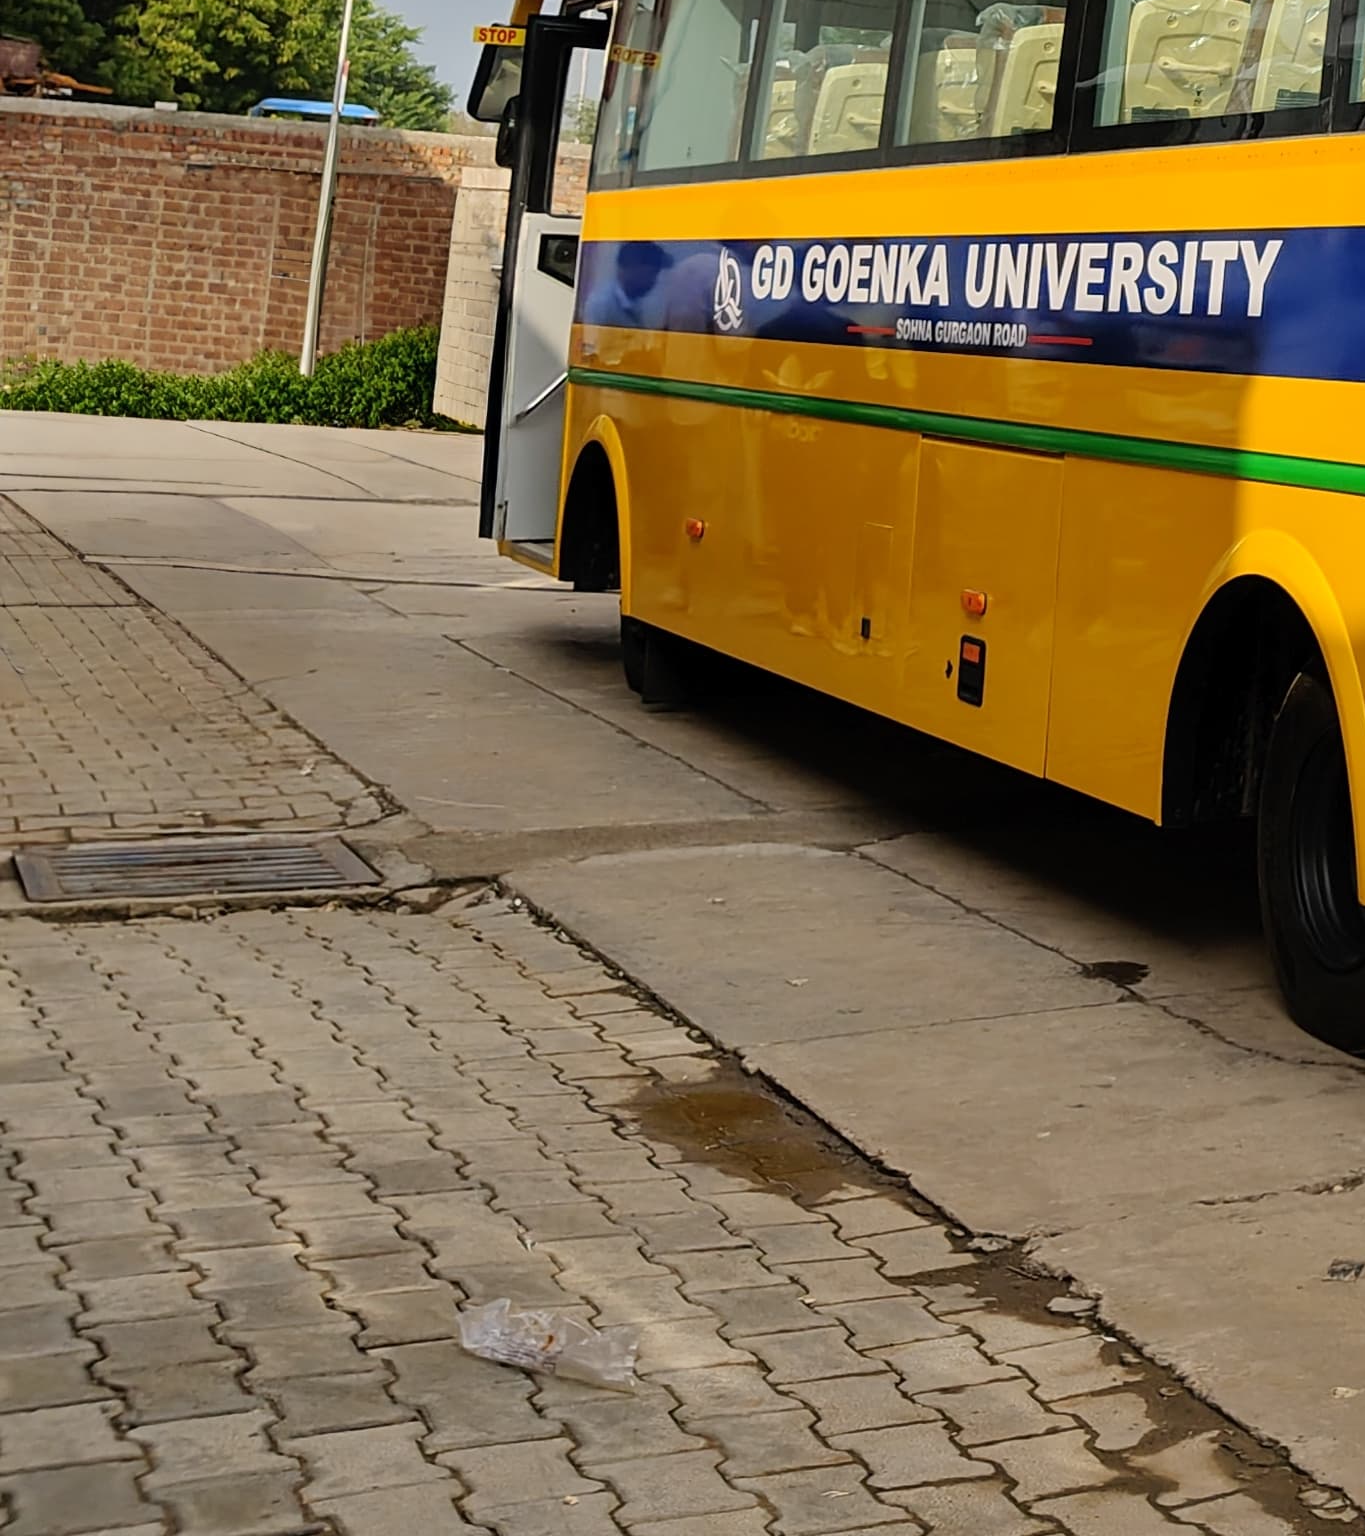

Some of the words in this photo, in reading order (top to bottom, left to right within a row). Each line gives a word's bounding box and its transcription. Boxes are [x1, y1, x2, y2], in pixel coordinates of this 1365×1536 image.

[478, 27, 517, 44] STOP
[750, 244, 795, 301] GD
[801, 243, 950, 308] GOENKA
[964, 239, 1284, 318] UNIVERSITY
[896, 318, 932, 342] SOHNA
[935, 320, 991, 345] GURGAON
[992, 323, 1027, 347] ROAD
